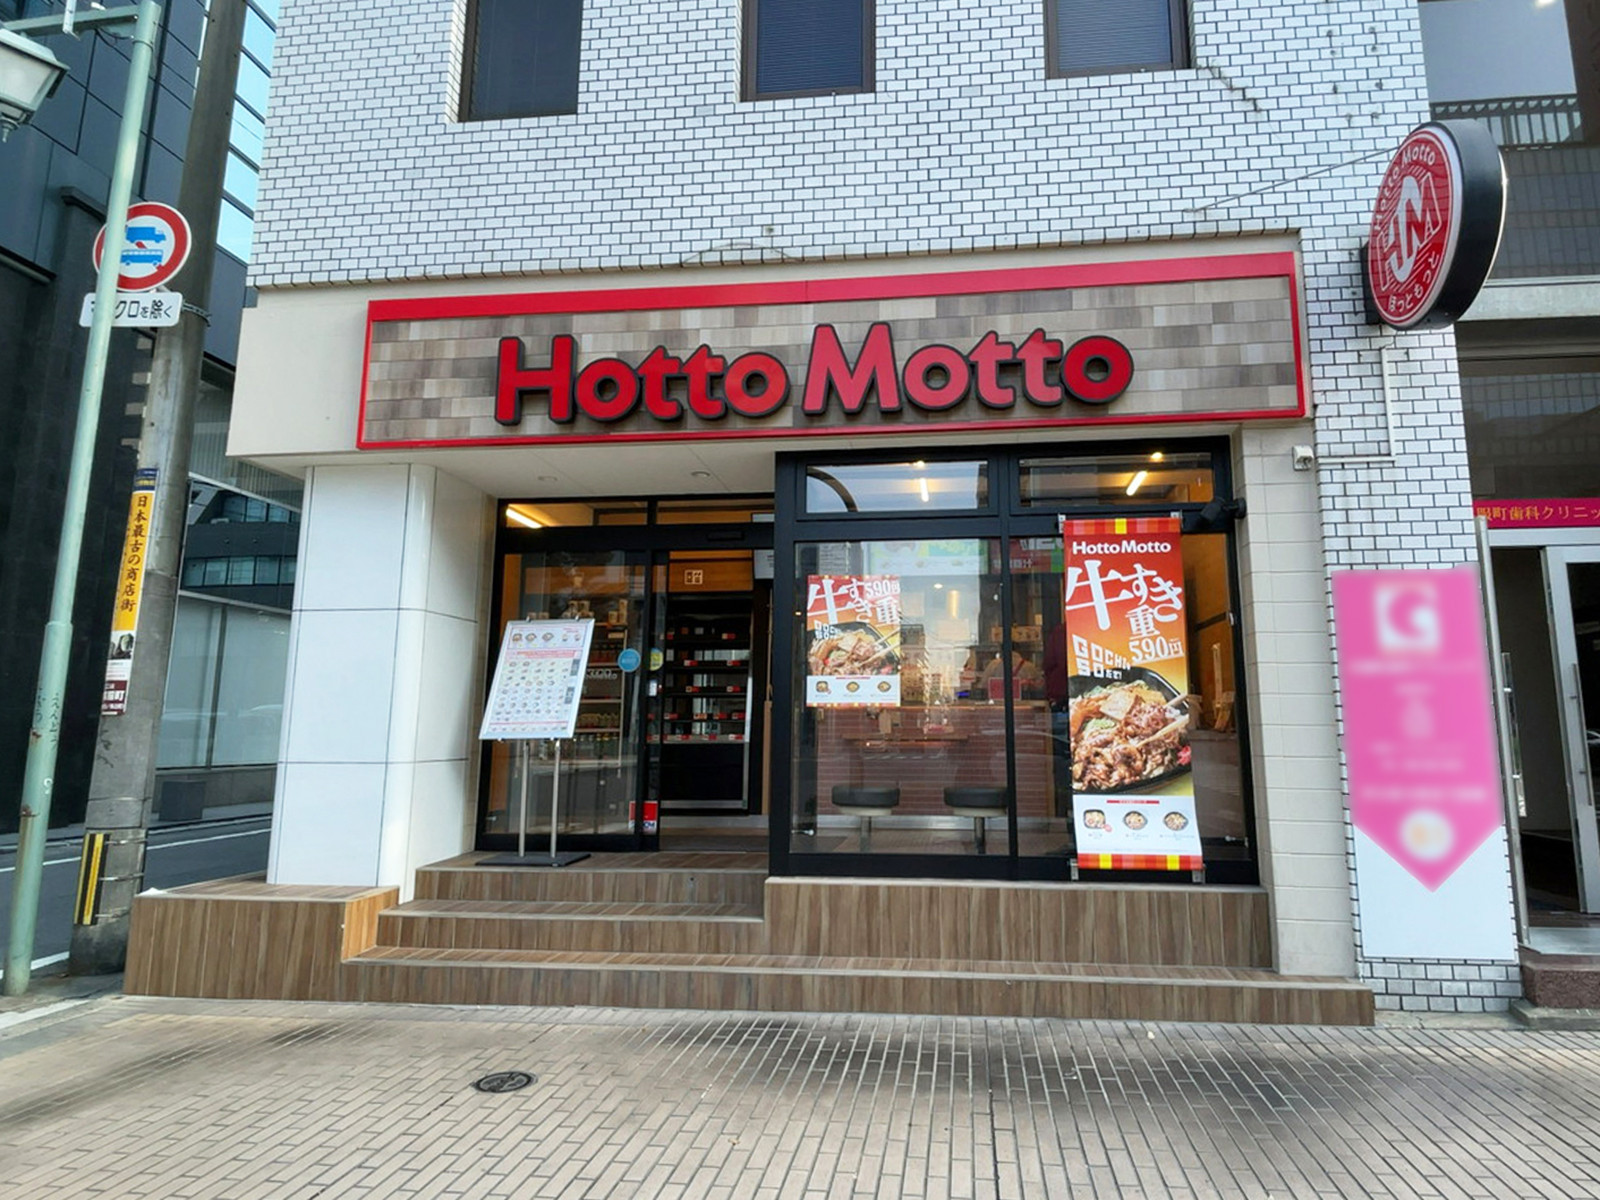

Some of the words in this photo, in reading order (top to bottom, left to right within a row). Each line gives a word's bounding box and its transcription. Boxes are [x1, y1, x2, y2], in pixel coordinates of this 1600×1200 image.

[1401, 144, 1436, 176] Motto
[90, 300, 172, 320] クロを除く
[495, 334, 791, 426] Hotto
[801, 321, 1134, 415] Motto
[120, 495, 149, 612] 日本最古の商店街
